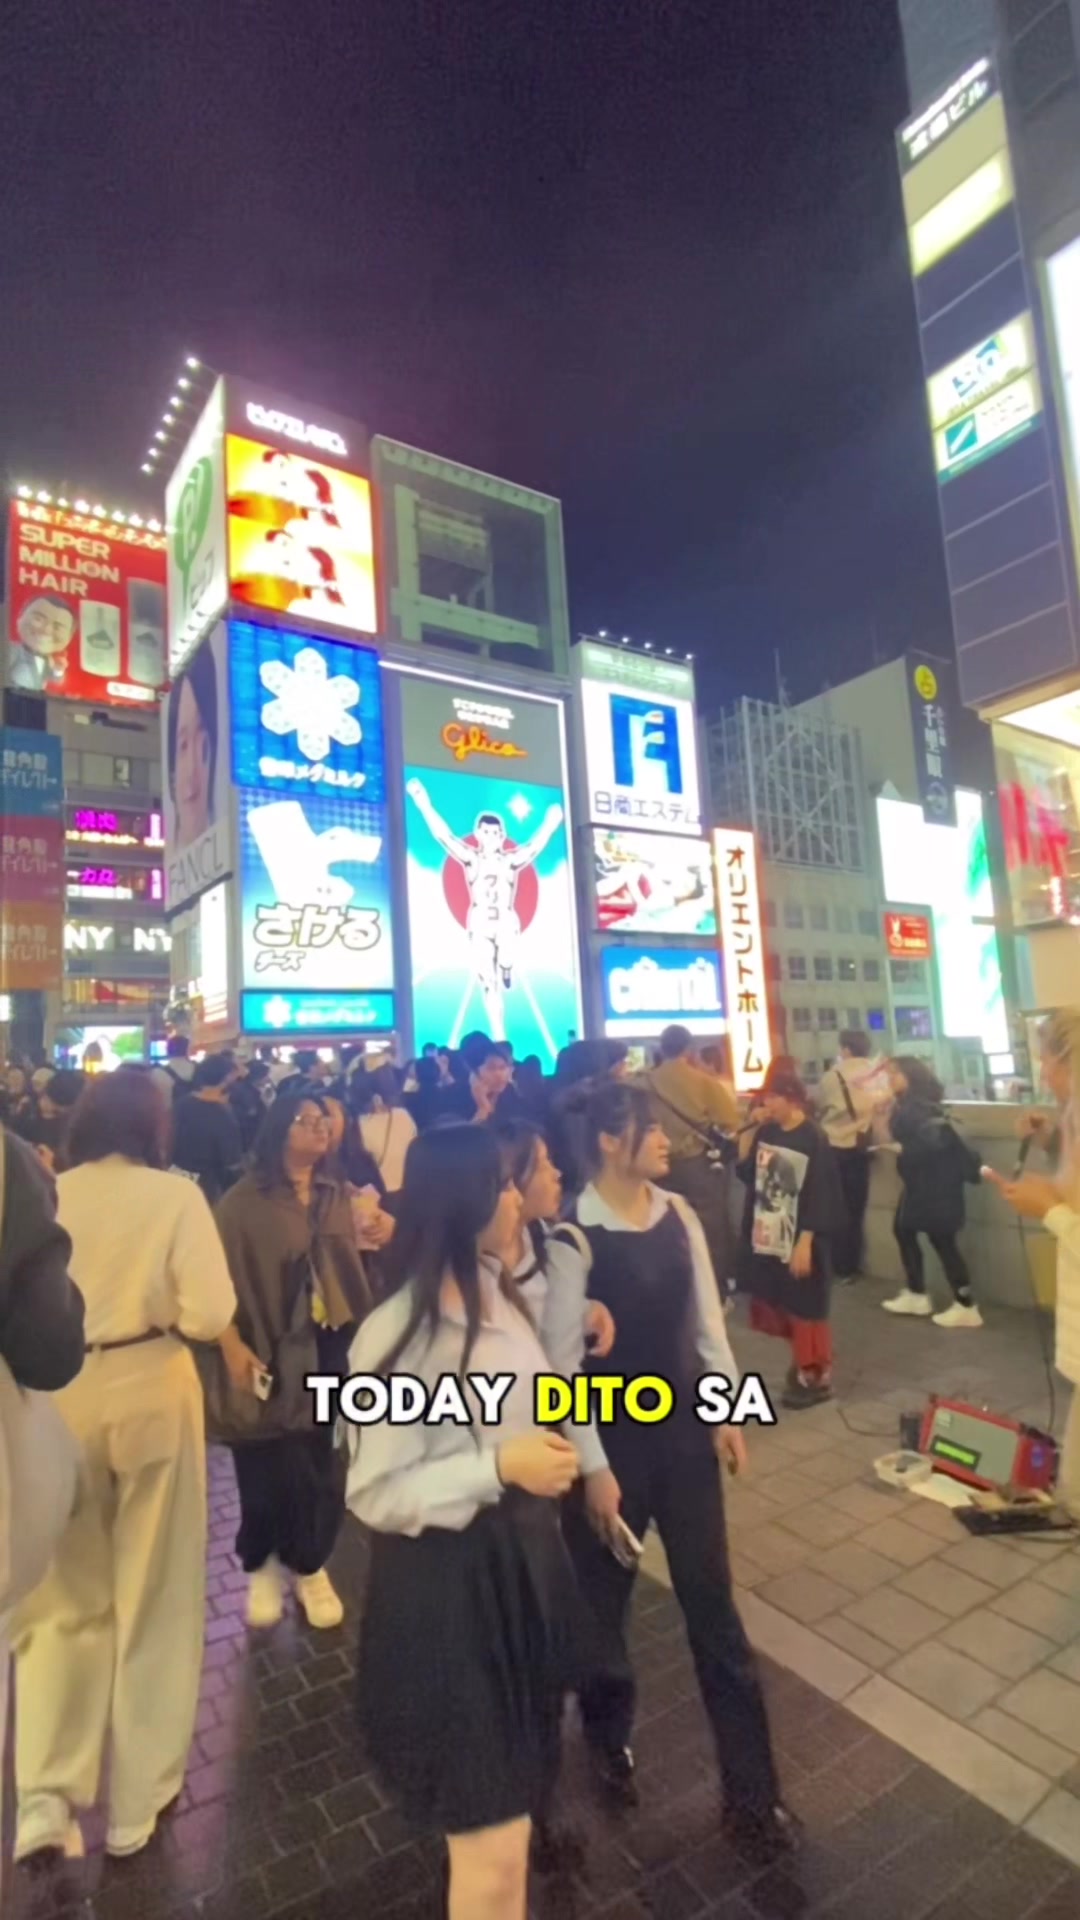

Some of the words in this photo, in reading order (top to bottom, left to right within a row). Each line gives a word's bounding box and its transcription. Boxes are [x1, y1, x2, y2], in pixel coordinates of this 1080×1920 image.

[19, 523, 111, 560] SUPER
[18, 567, 89, 597] HAIR
[19, 544, 120, 584] MILLION
[168, 831, 224, 898] FANCL
[64, 926, 113, 951] NY
[253, 902, 381, 950] さける
[254, 948, 307, 973] チーズ
[725, 845, 766, 1074] オリエントホーム
